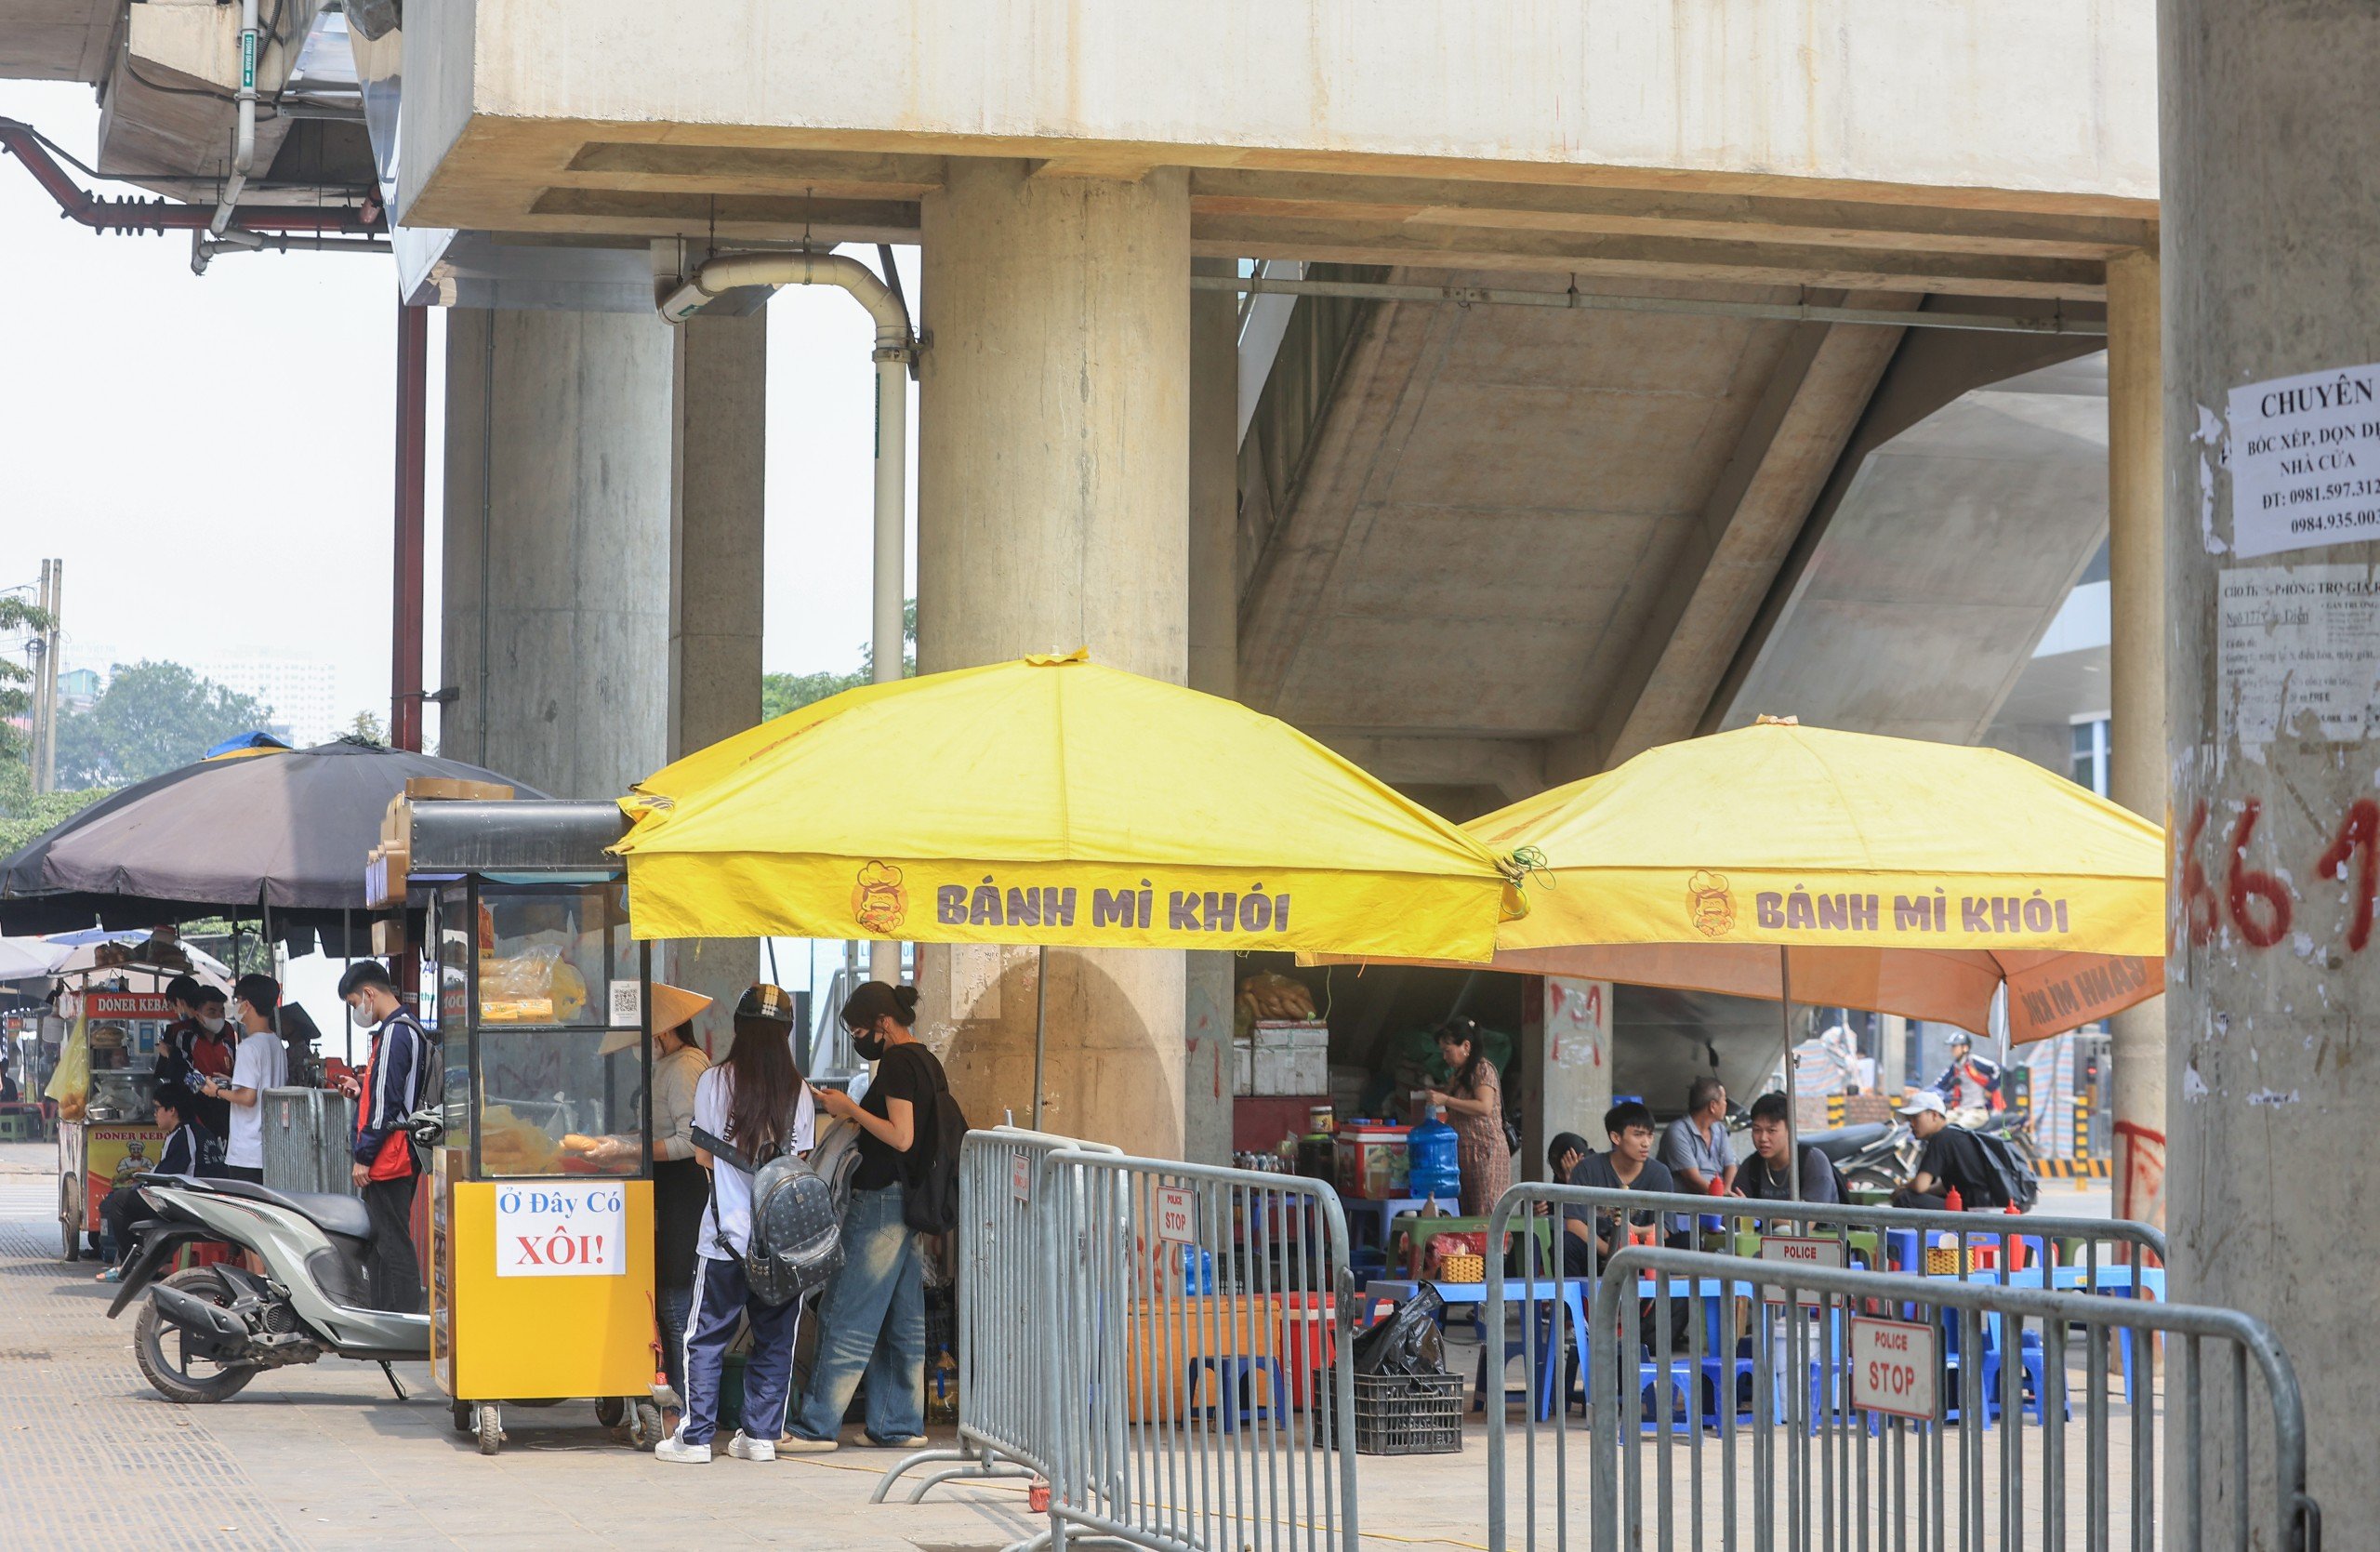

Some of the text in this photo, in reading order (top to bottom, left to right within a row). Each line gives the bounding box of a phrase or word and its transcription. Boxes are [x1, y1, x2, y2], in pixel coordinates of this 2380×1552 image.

[2261, 374, 2373, 418] CHUYÊN
[2320, 424, 2355, 445] DỌN
[936, 874, 1290, 933] BÁNH MÌ KHÓI
[1755, 883, 2069, 934] BÁNH MÌ KHÓI
[98, 996, 174, 1012] DÖNER KEBA
[499, 1187, 621, 1219] Ở Đây Có
[1167, 1194, 1183, 1205] POLICE
[1165, 1212, 1186, 1231] STOP
[515, 1226, 603, 1265] XÔI!
[1784, 1245, 1817, 1259] POLICE
[1874, 1331, 1908, 1351] POLICE
[1870, 1360, 1914, 1396] STOP
